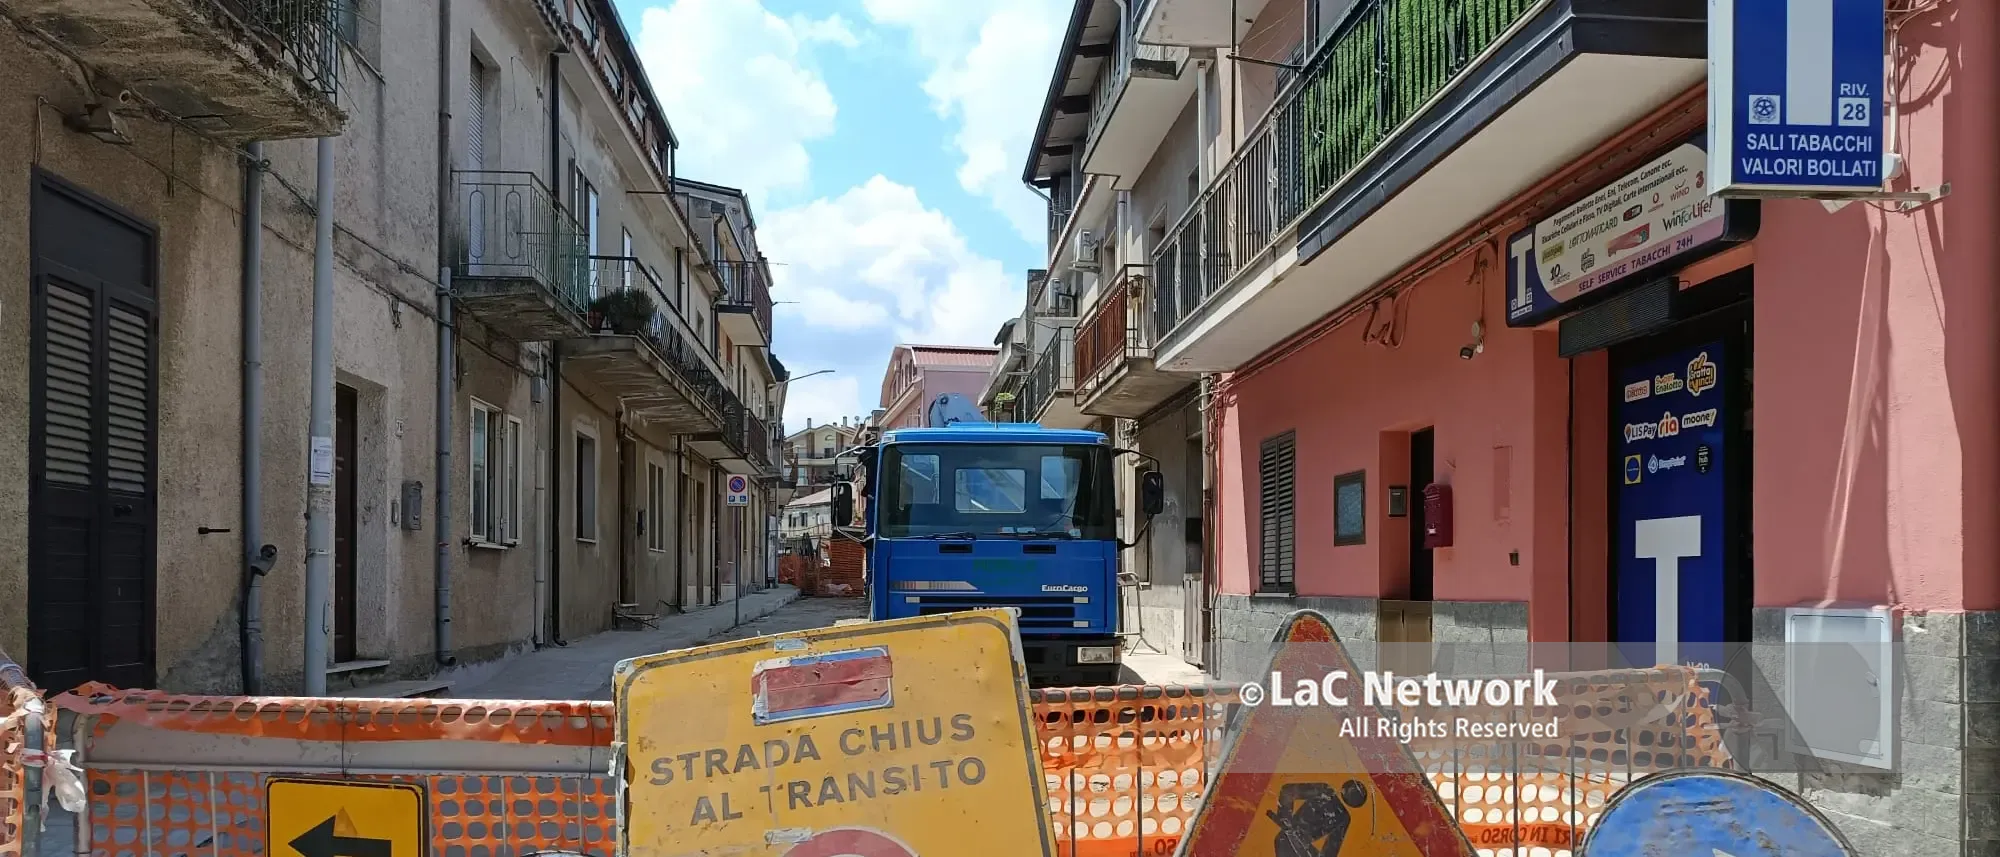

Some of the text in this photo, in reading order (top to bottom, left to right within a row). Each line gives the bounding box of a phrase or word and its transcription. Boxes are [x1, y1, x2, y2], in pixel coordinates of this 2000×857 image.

[1840, 83, 1869, 96] RIV.
[1843, 103, 1866, 120] 28
[1747, 133, 1872, 152] SALI TABACCHI
[1640, 164, 1661, 181] Canone
[1742, 157, 1876, 177] VALORI BOLLATI
[1695, 170, 1705, 189] 3
[1595, 206, 1603, 216] TV
[1623, 190, 1637, 202] Carte
[1669, 186, 1690, 201] WIND
[1511, 232, 1533, 308] T
[1578, 234, 1693, 293] SELF SERVICE TABACCHI 24H
[1659, 413, 1677, 436] ria
[1041, 584, 1088, 594] EuroCargo
[650, 713, 976, 786] STRADA CHIUS
[690, 757, 987, 826] AL TRANSITO
